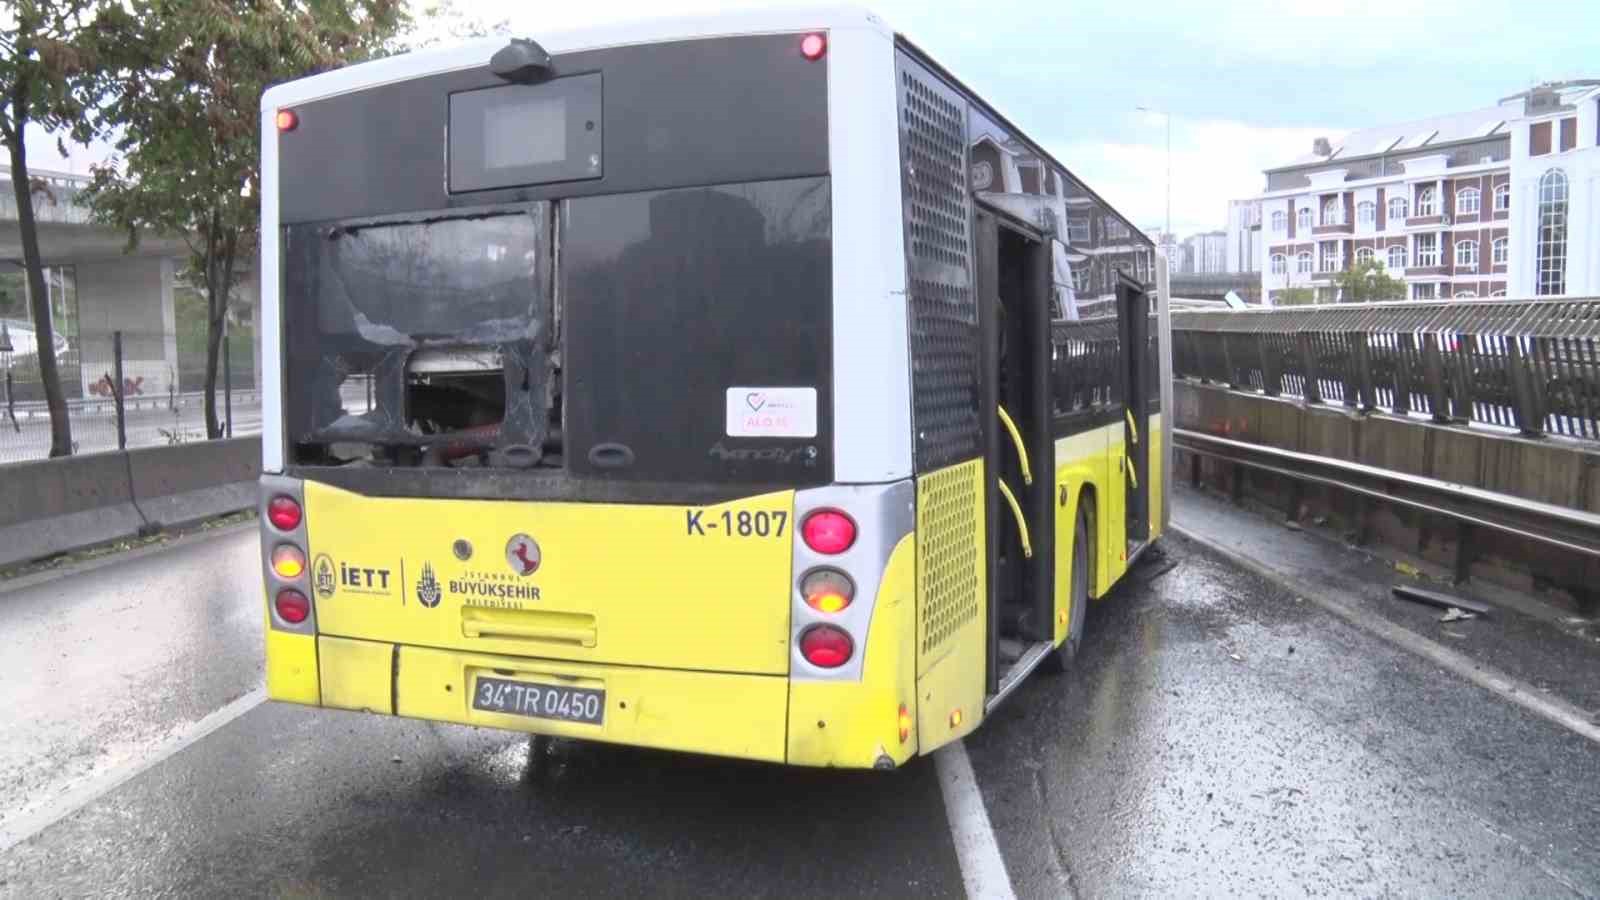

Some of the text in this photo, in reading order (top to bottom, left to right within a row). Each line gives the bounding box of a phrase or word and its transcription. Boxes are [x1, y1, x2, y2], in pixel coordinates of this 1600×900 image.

[687, 510, 787, 537] K-1807
[341, 562, 390, 589] İETT
[449, 577, 541, 601] BÜYÜKŞEHİR
[480, 682, 599, 719] 34 TR 0450
